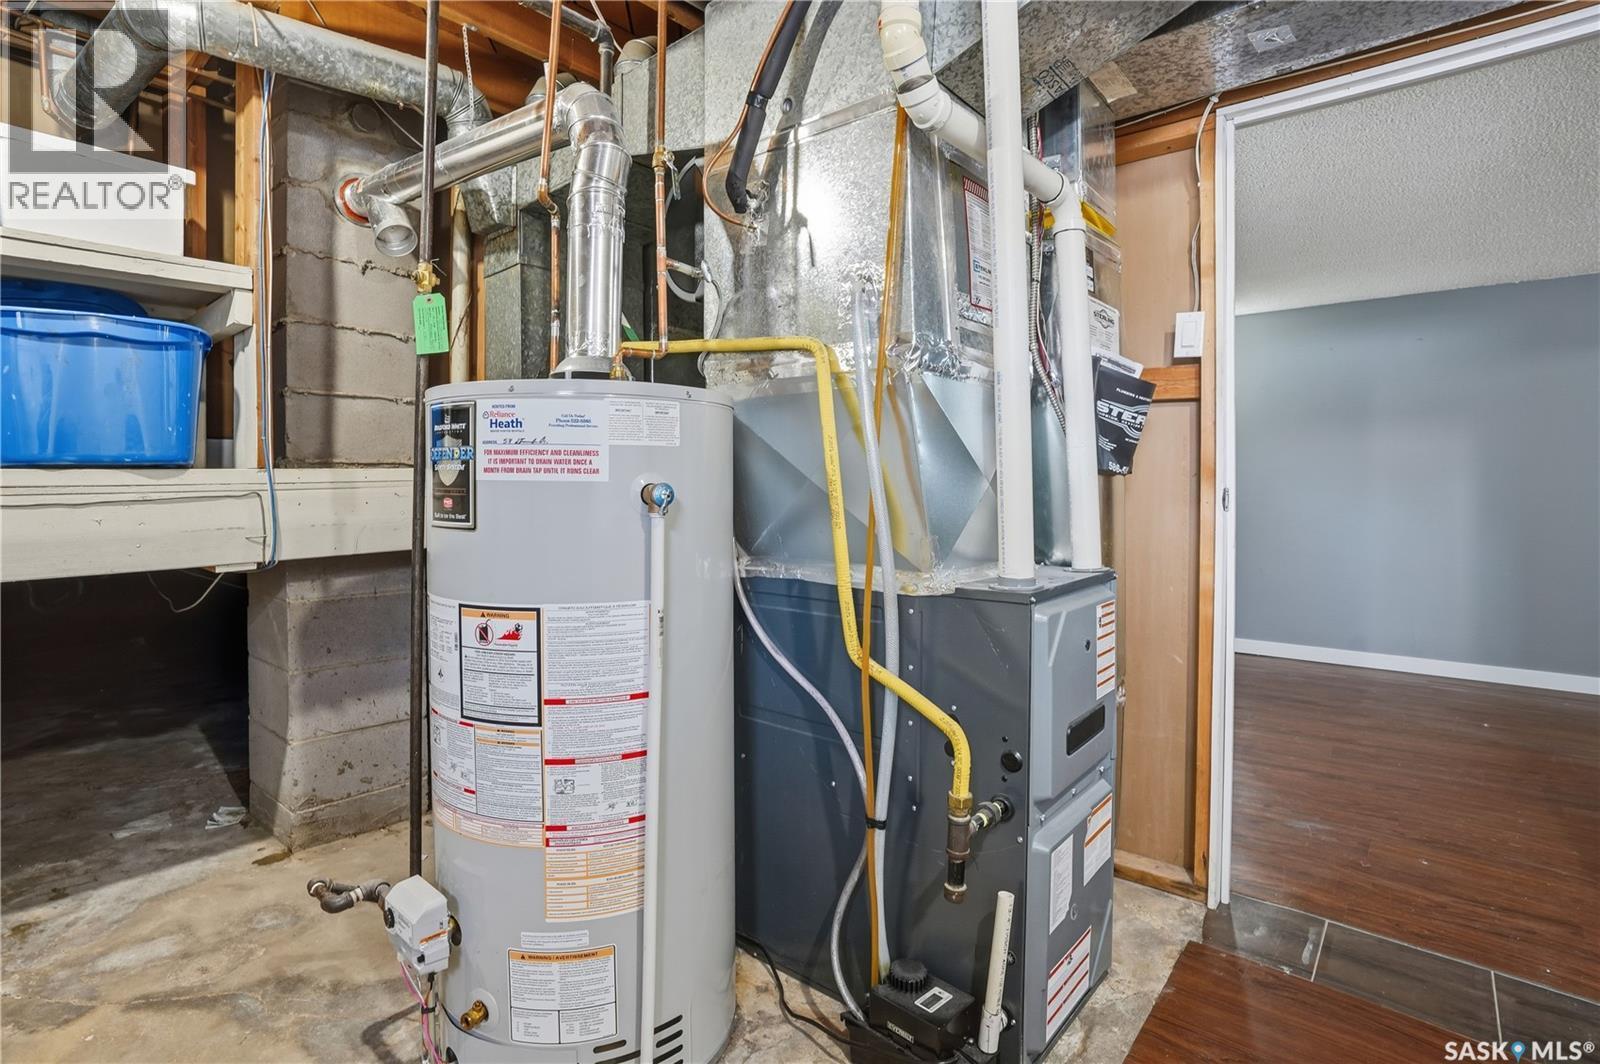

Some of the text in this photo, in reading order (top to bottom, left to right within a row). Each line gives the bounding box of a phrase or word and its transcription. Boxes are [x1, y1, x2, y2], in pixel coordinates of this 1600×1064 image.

[490, 410, 516, 418] Reliance
[490, 418, 522, 428] Heath
[431, 447, 474, 460] DEFENDER
